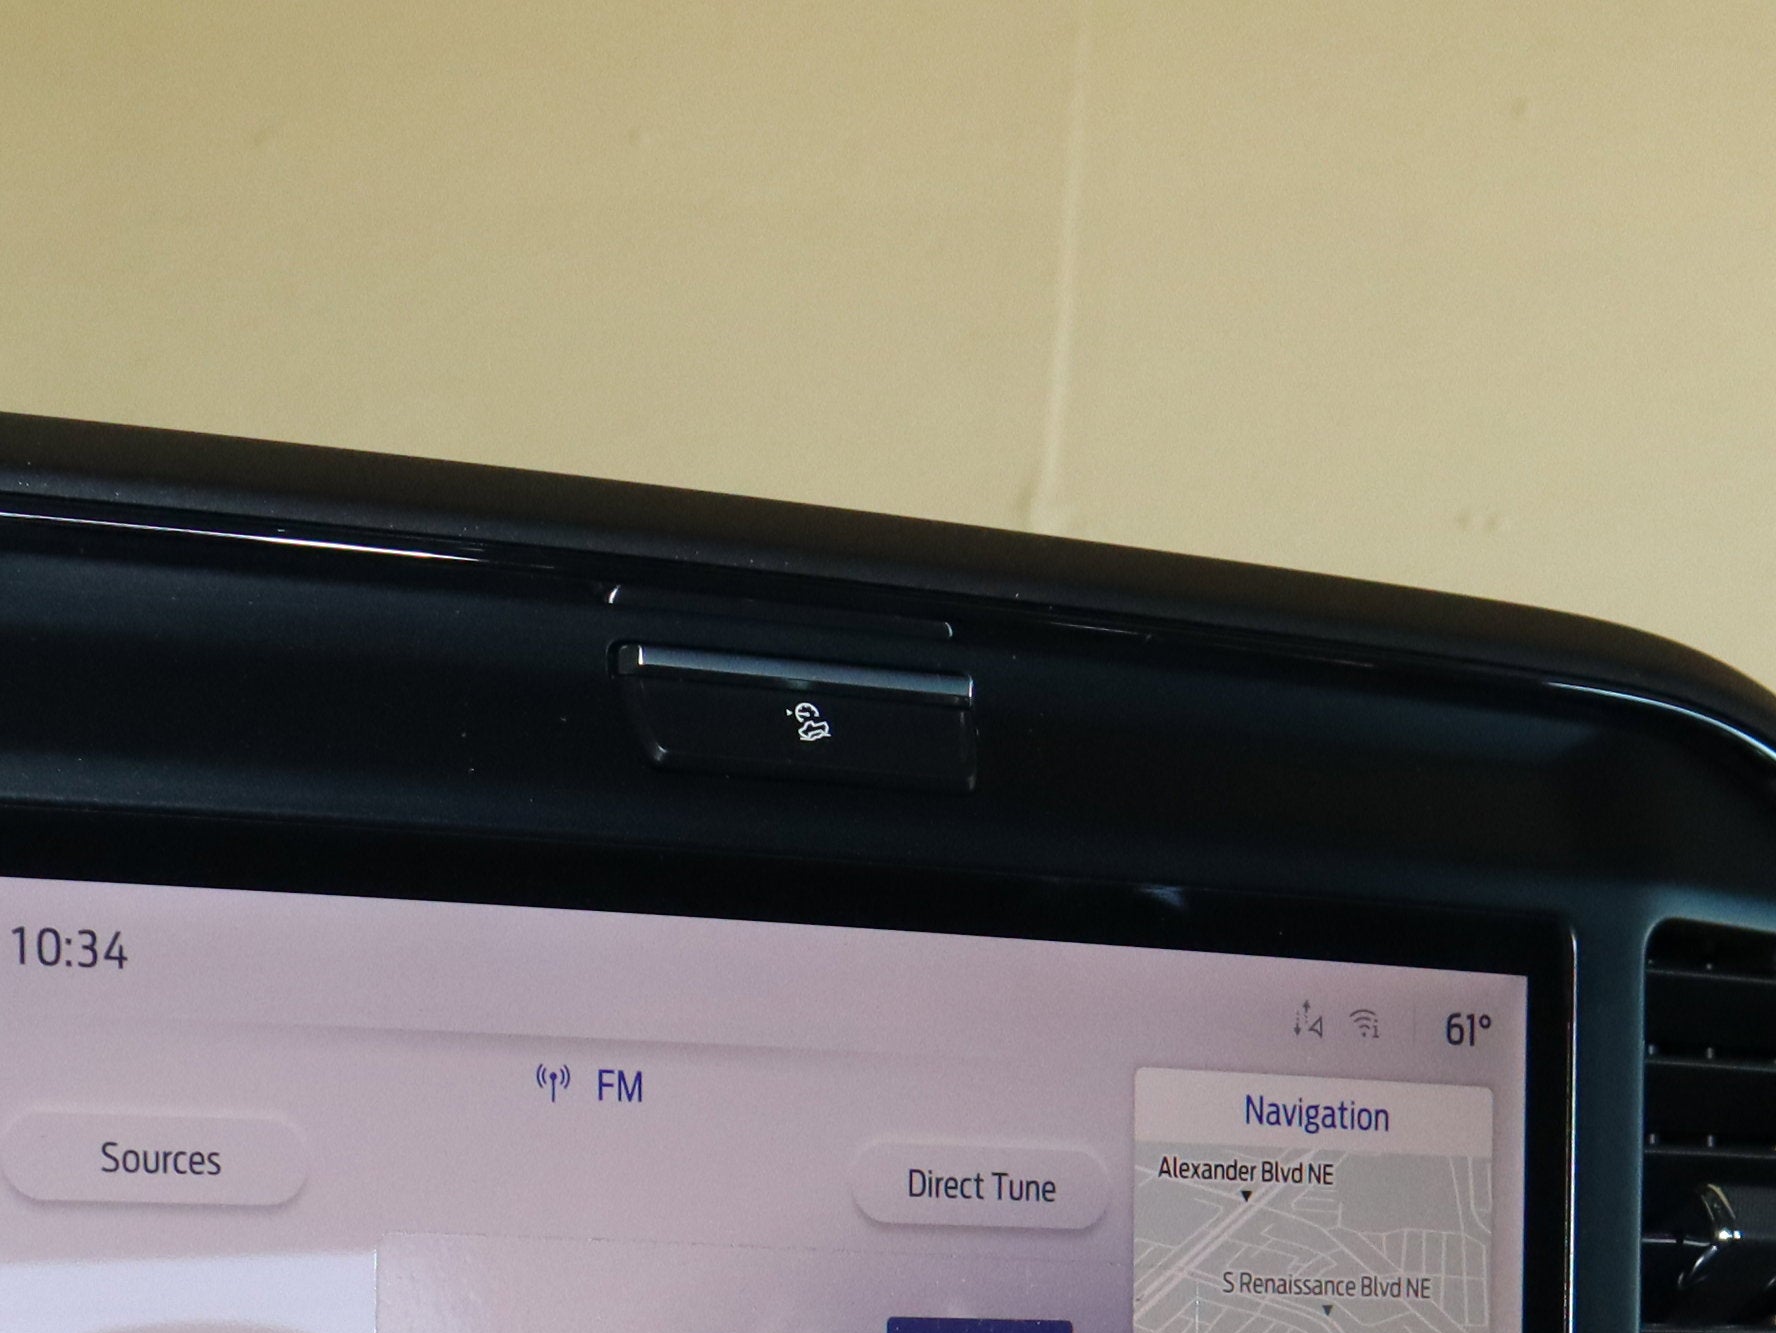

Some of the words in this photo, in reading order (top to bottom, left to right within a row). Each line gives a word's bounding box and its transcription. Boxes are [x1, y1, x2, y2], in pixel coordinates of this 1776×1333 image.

[11, 926, 128, 970] 10:34
[597, 1070, 644, 1103] FM
[1245, 1095, 1390, 1134] Navigation
[100, 1141, 222, 1177] Sources
[1158, 1156, 1257, 1181] Alexander
[1261, 1161, 1303, 1183] Blvd
[1308, 1164, 1334, 1184] NE
[908, 1169, 983, 1202] Direct
[991, 1171, 1057, 1203] Tune
[1223, 1272, 1234, 1293] S
[1240, 1272, 1356, 1296] Renaissance
[1361, 1276, 1401, 1297] Blvd
[1406, 1278, 1431, 1298] NE
